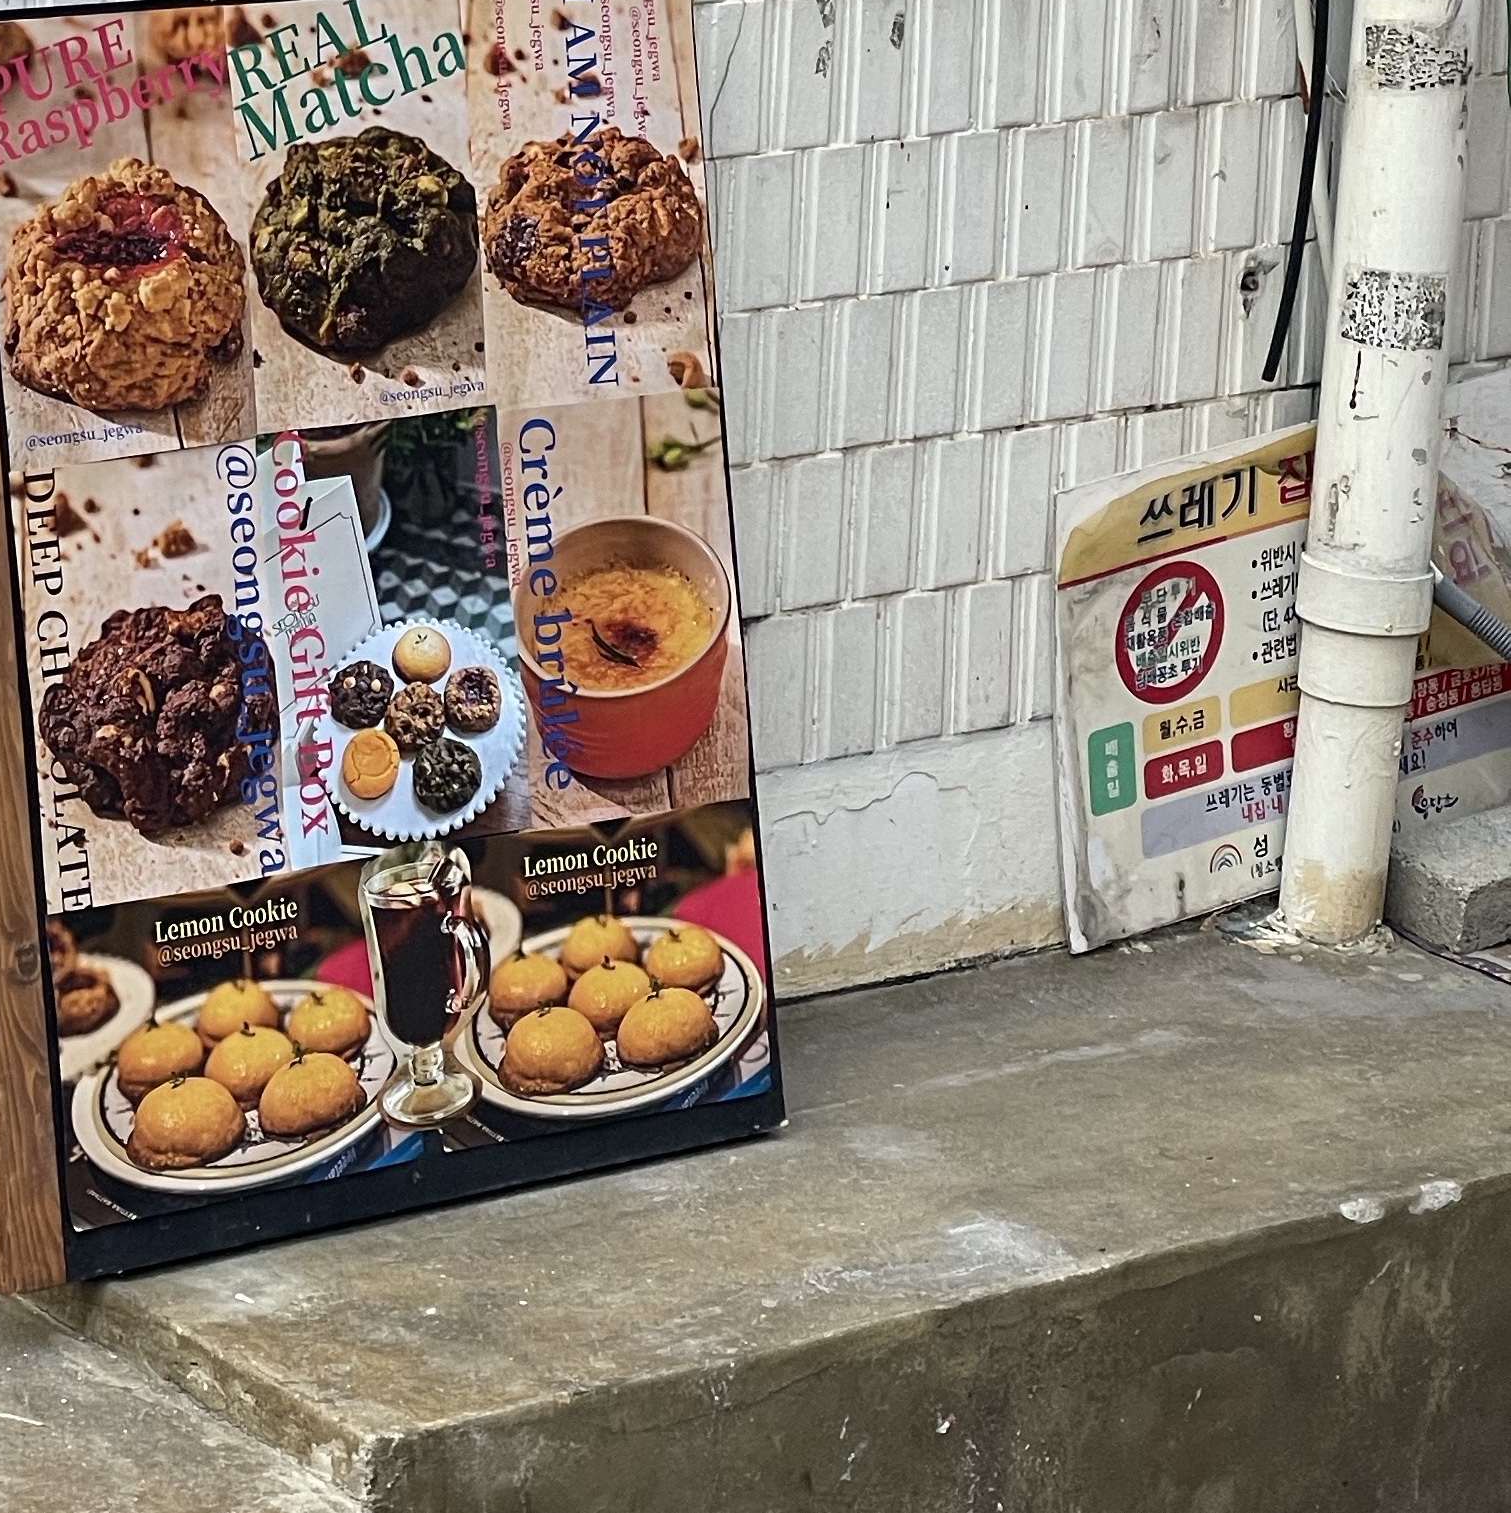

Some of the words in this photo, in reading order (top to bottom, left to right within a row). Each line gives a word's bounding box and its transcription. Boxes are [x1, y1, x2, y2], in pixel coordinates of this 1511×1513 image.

[565, 20, 600, 95] AM
[233, 31, 466, 162] Matcha
[571, 112, 609, 219] NOT
[577, 233, 620, 386] PLAIN
[379, 379, 485, 406] @seongsu_jegwa
[26, 423, 144, 450] @seongsu_jegwa
[23, 468, 64, 595] DEEP
[271, 430, 323, 612] Cookie
[518, 417, 564, 598] Crème
[1138, 466, 1255, 544] 쓰레기
[1261, 541, 1295, 572] 위반시
[215, 444, 282, 878] @seongsu_jegwa
[288, 626, 331, 723] Gift
[1159, 709, 1205, 740] 월,수,금
[1410, 720, 1458, 749] 준수하여
[297, 736, 336, 838] Box
[1161, 753, 1207, 784] 화,목,일
[1205, 783, 1255, 813] 쓰레기는
[523, 852, 589, 878] Lemon
[593, 838, 658, 866] Cookie
[527, 864, 657, 900] @seongsu_jegwa
[155, 912, 224, 943] Lemon
[229, 898, 298, 931] Cookie
[157, 922, 298, 967] @seongsu_jegwa
